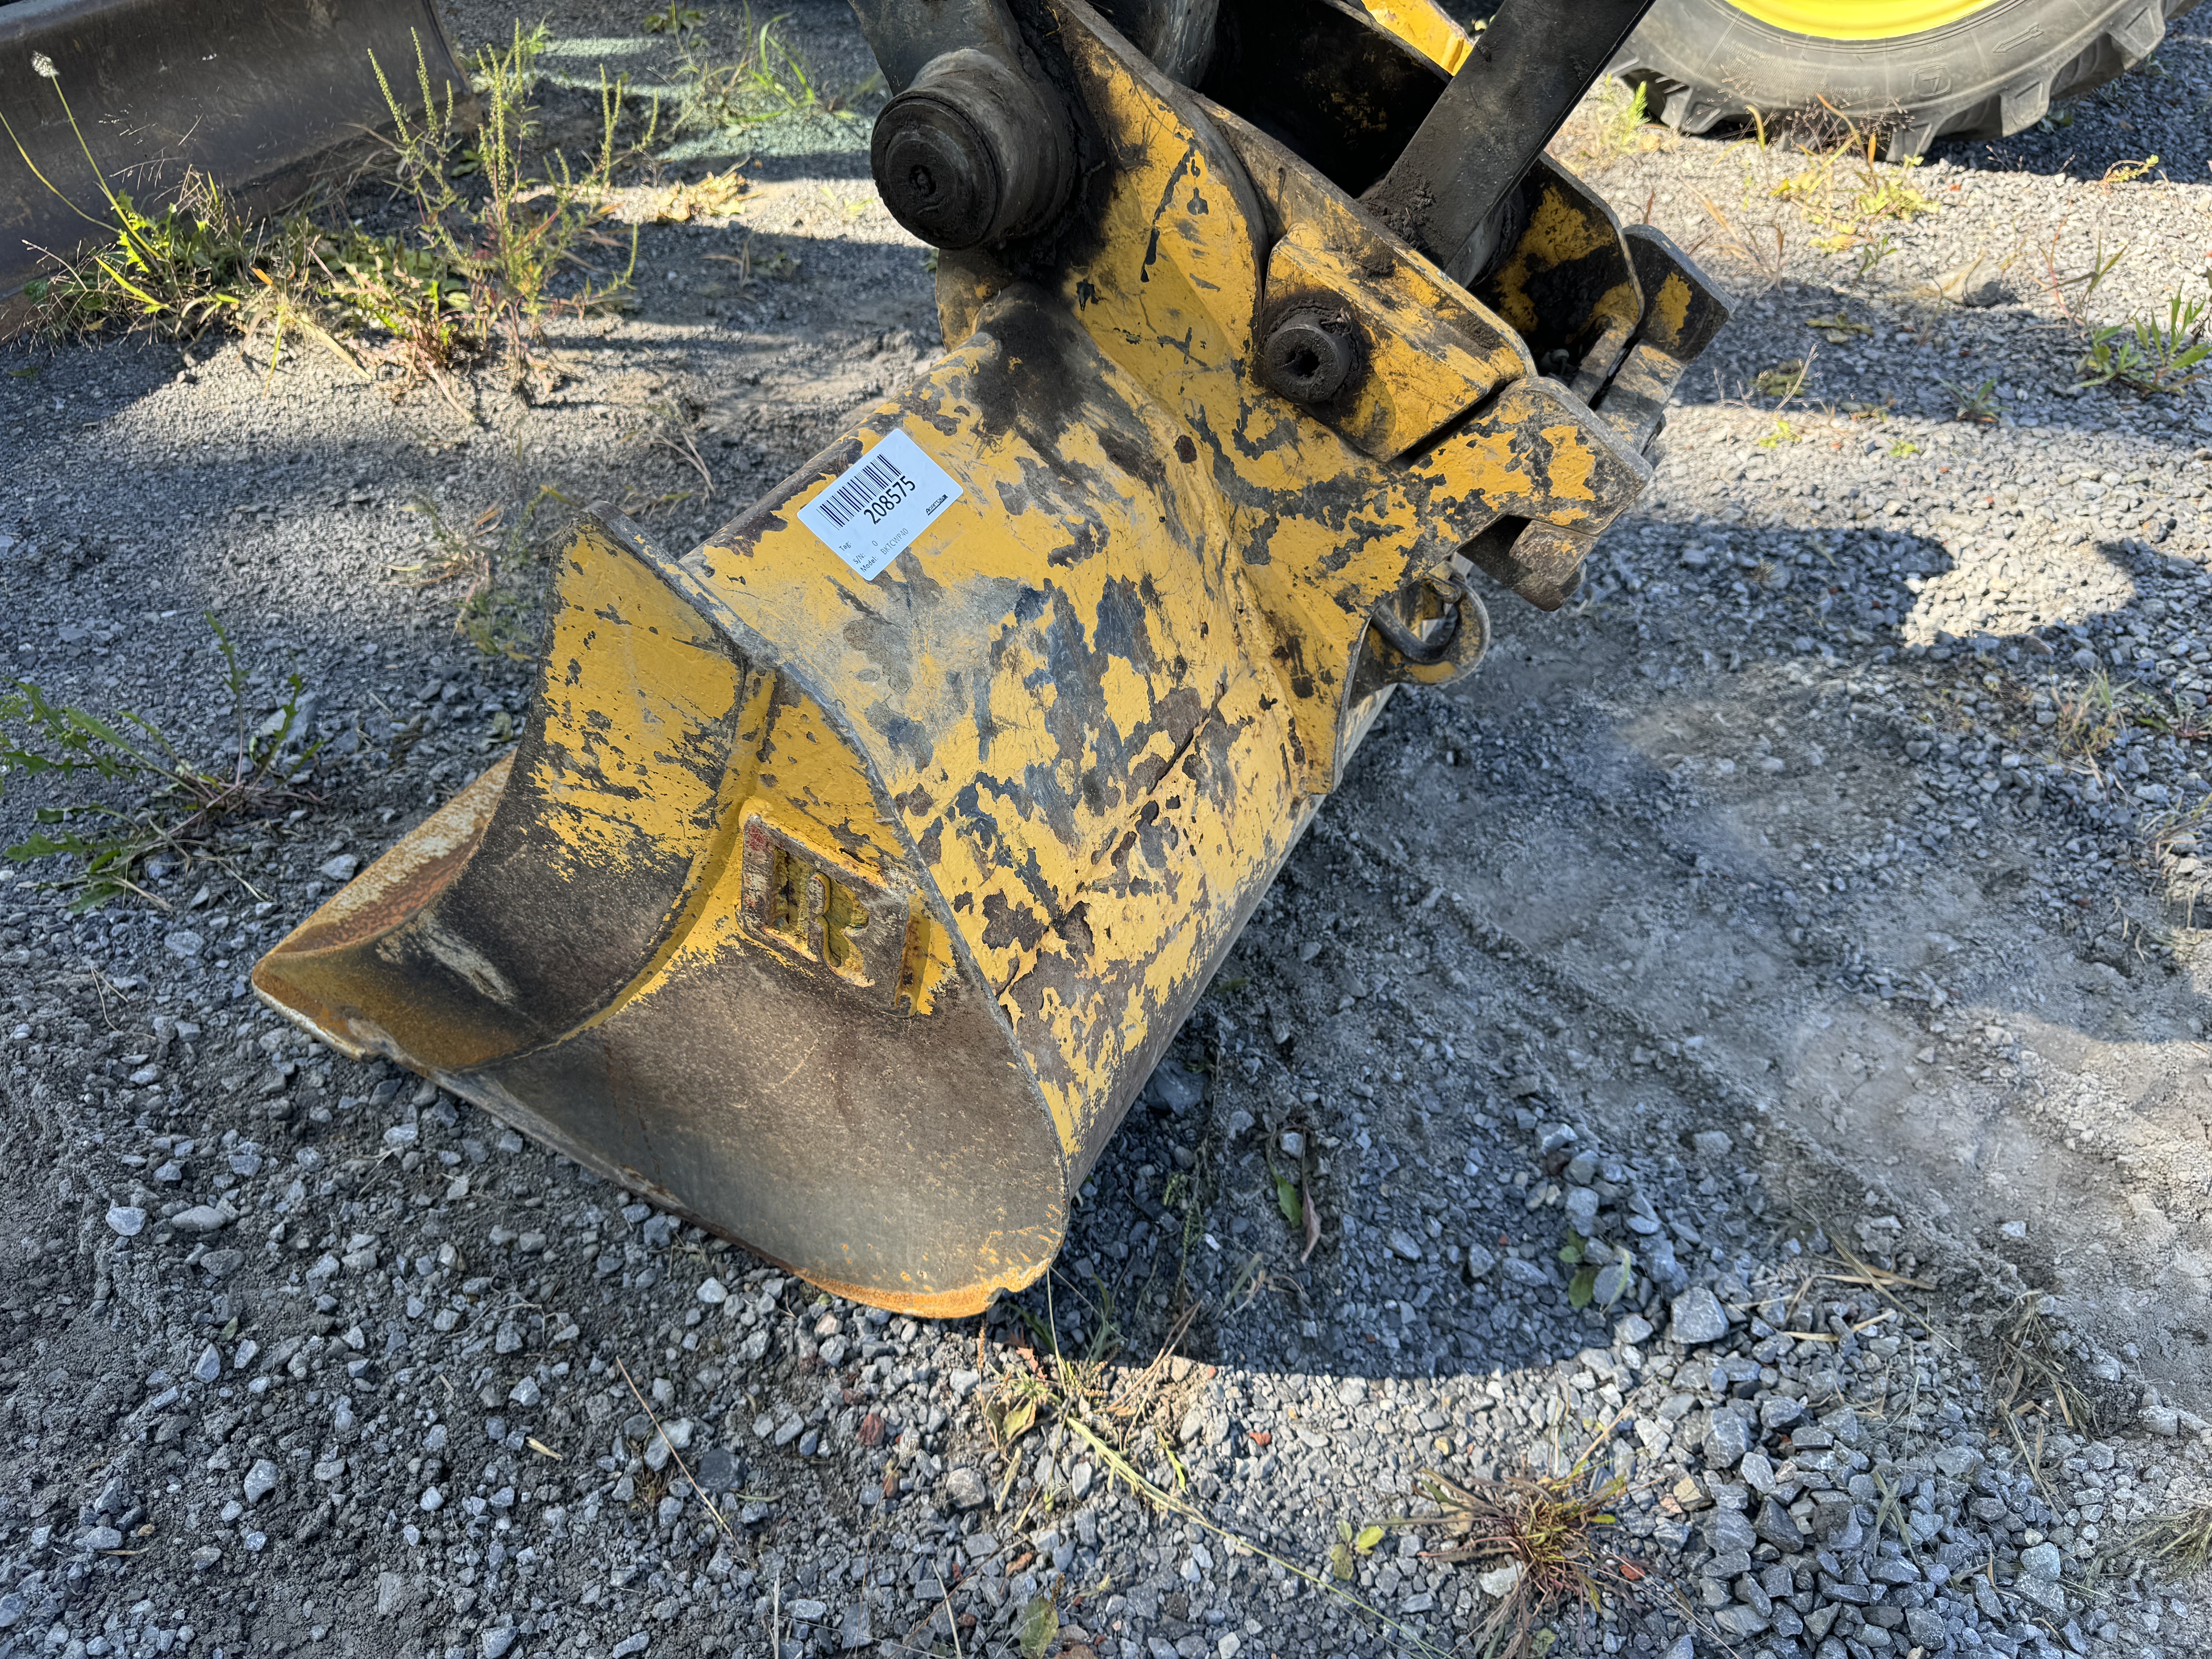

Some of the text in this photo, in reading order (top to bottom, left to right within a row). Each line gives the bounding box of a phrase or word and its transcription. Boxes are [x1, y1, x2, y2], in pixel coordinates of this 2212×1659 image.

[864, 476, 915, 524] 208575
[839, 541, 852, 551] Tag:
[853, 553, 866, 564] S/N:
[860, 528, 908, 572] Model: BKTCWP40
